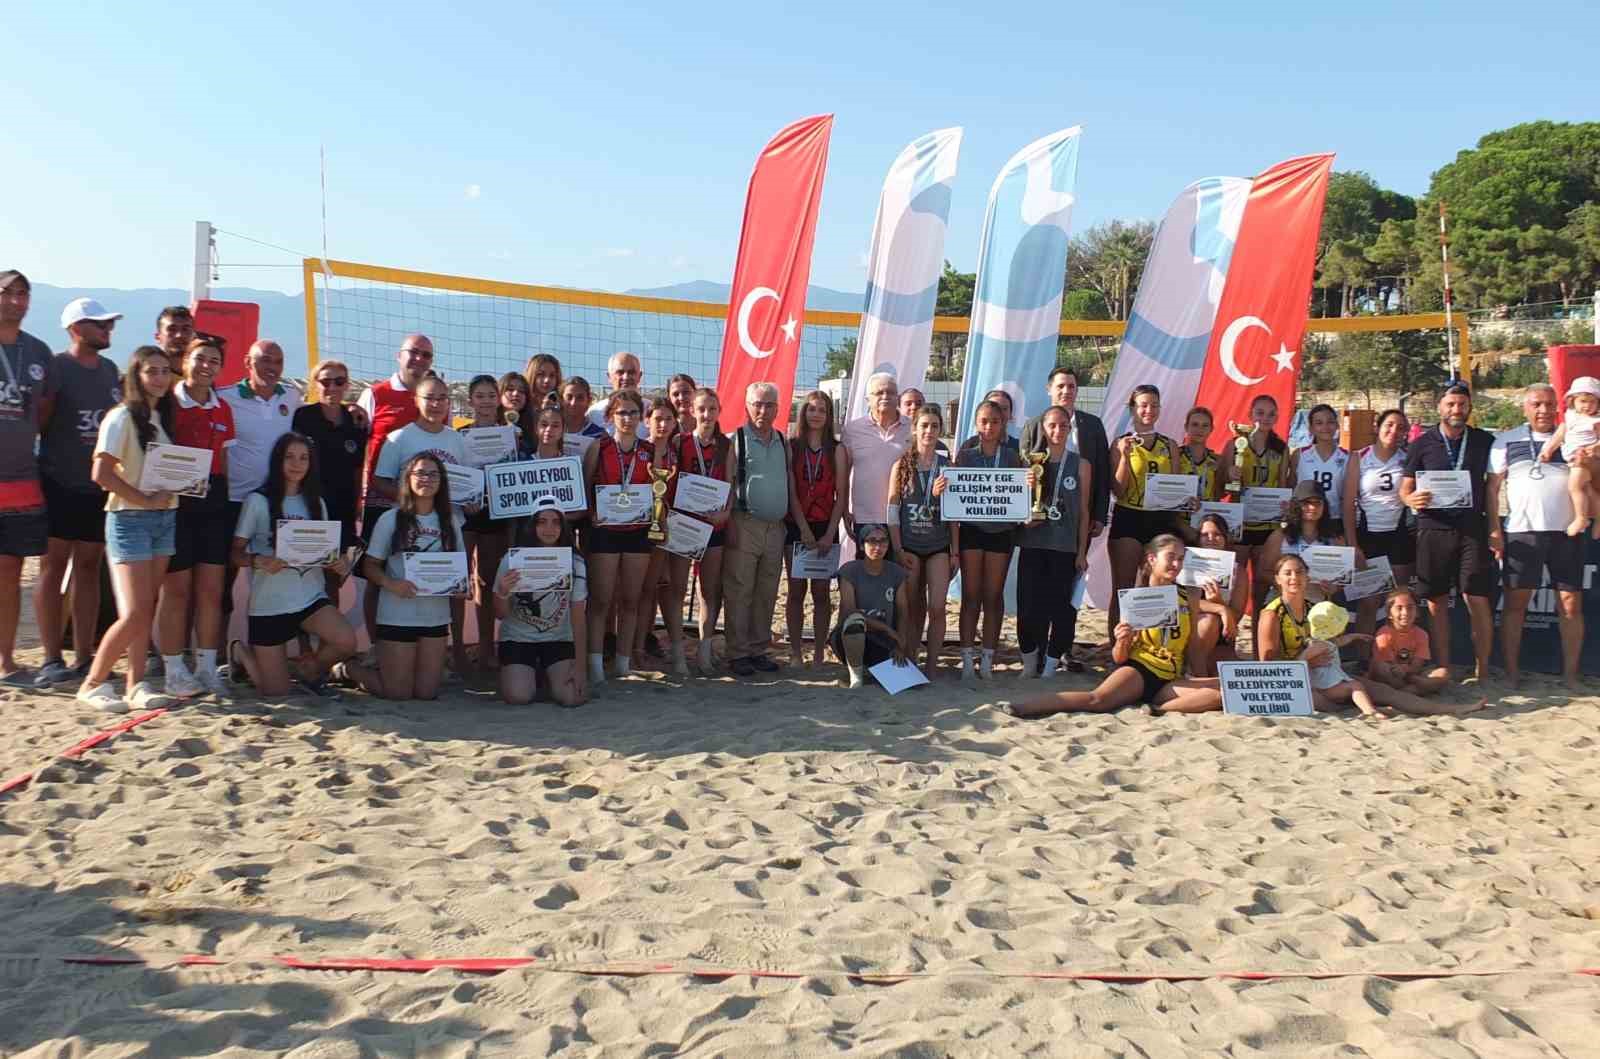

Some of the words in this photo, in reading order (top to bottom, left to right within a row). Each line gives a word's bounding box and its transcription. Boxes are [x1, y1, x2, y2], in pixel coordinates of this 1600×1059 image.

[495, 471, 516, 489] TED
[519, 467, 574, 485] VOLEYBOL
[957, 473, 992, 482] KUZEY
[994, 473, 1015, 483] EGE
[1313, 470, 1333, 491] 18
[1379, 473, 1394, 491] 3
[949, 483, 992, 495] GELİŞİM
[994, 484, 1023, 494] SPOR
[500, 491, 529, 508] SPOR
[959, 495, 1014, 505] VOLEYBOL
[965, 505, 1008, 516] KULÜBÜ
[1234, 668, 1294, 678] BURHANİYE
[1240, 692, 1295, 702] VOLEYBOL
[1248, 703, 1291, 714] KULÜBÜ
